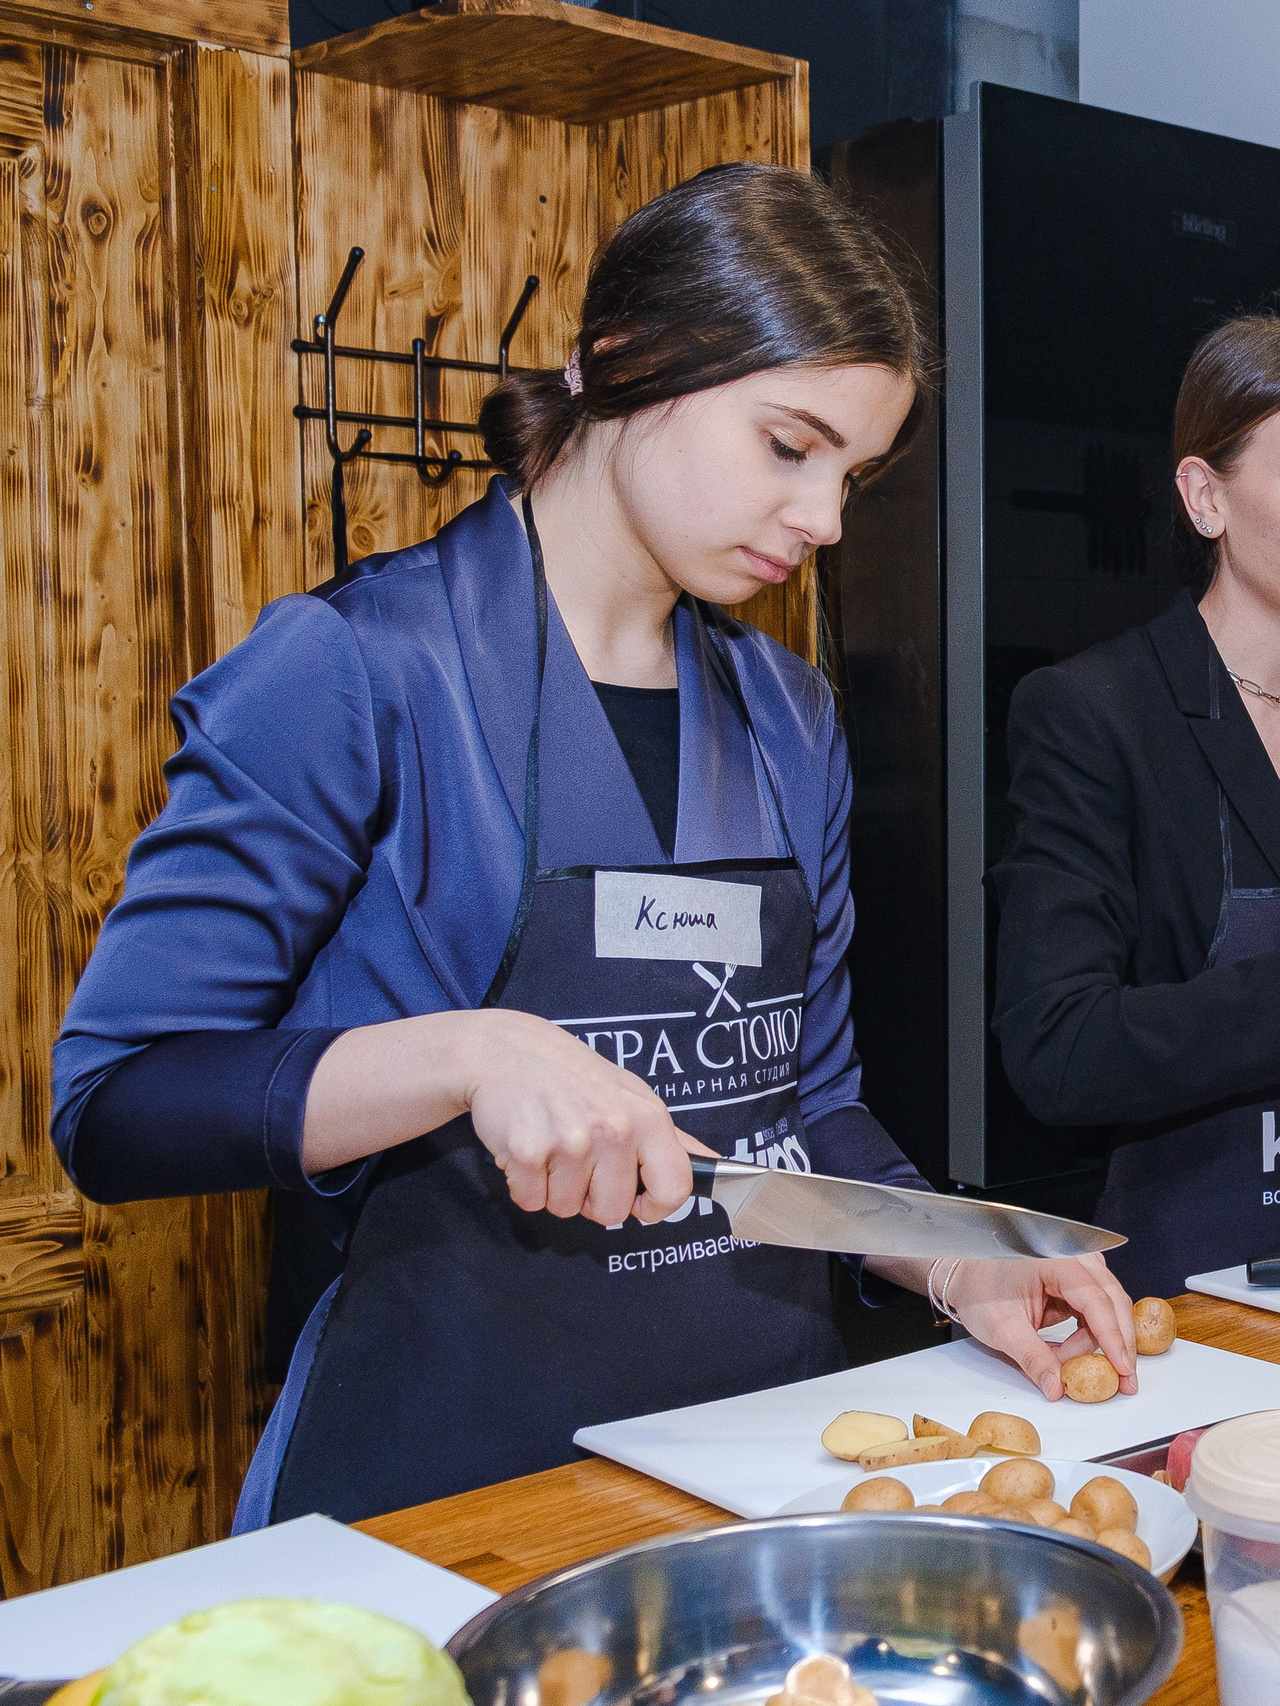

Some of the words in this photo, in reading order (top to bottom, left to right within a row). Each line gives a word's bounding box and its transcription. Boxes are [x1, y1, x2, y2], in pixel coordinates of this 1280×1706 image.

[634, 895, 719, 932] Ксюша
[575, 1028, 685, 1077] ГРА
[696, 1006, 803, 1069] СТОЛО
[755, 1062, 790, 1085] СТУДИЯ
[608, 1234, 763, 1272] встраиваем
